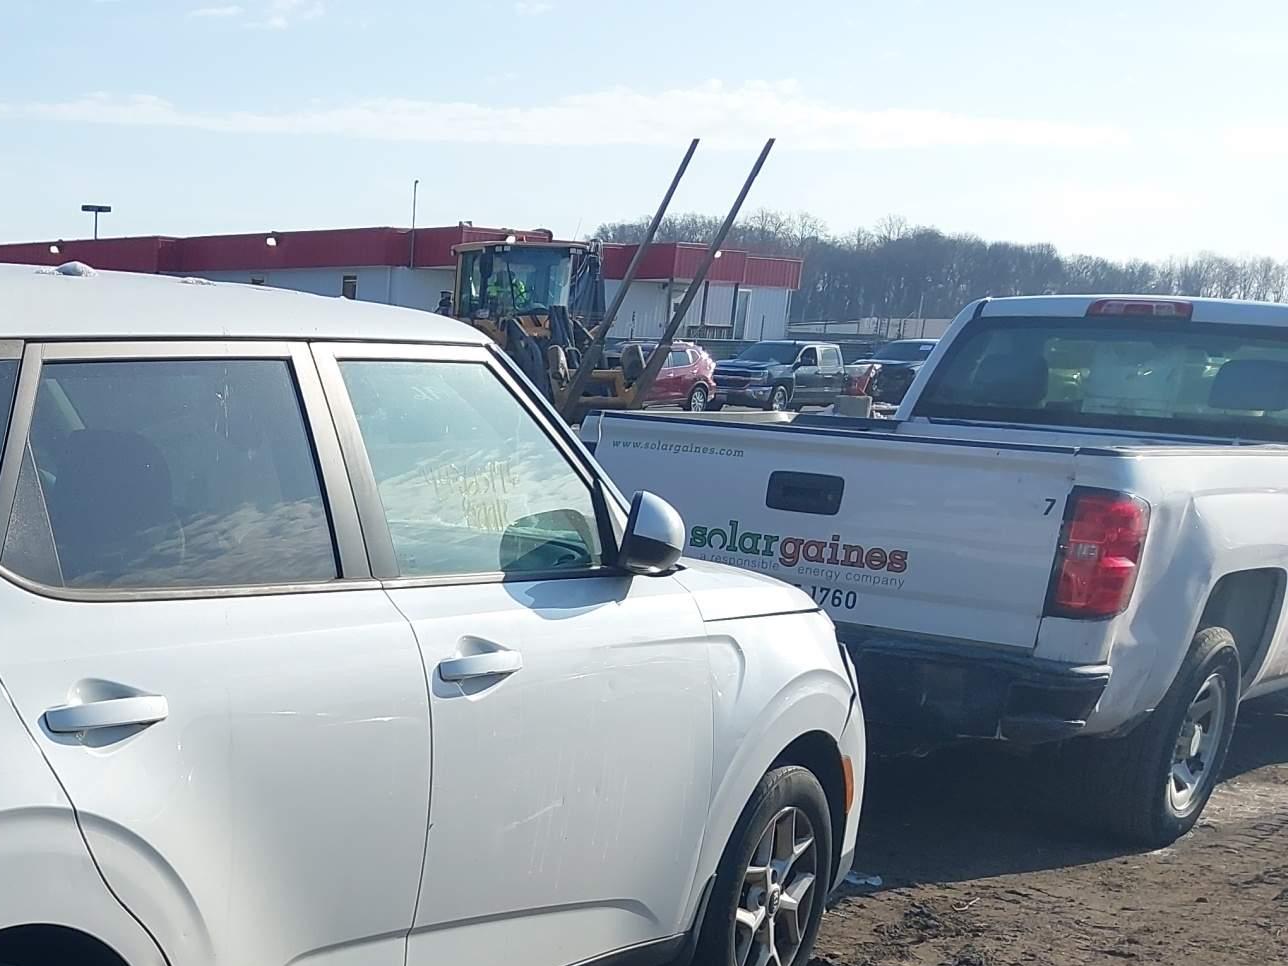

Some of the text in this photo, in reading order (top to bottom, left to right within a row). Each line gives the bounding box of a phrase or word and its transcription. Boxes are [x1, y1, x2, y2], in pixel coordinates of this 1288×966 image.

[612, 439, 745, 458] www.solargaines.com
[1043, 498, 1057, 516] 7
[797, 565, 841, 581] energy
[845, 571, 905, 590] company
